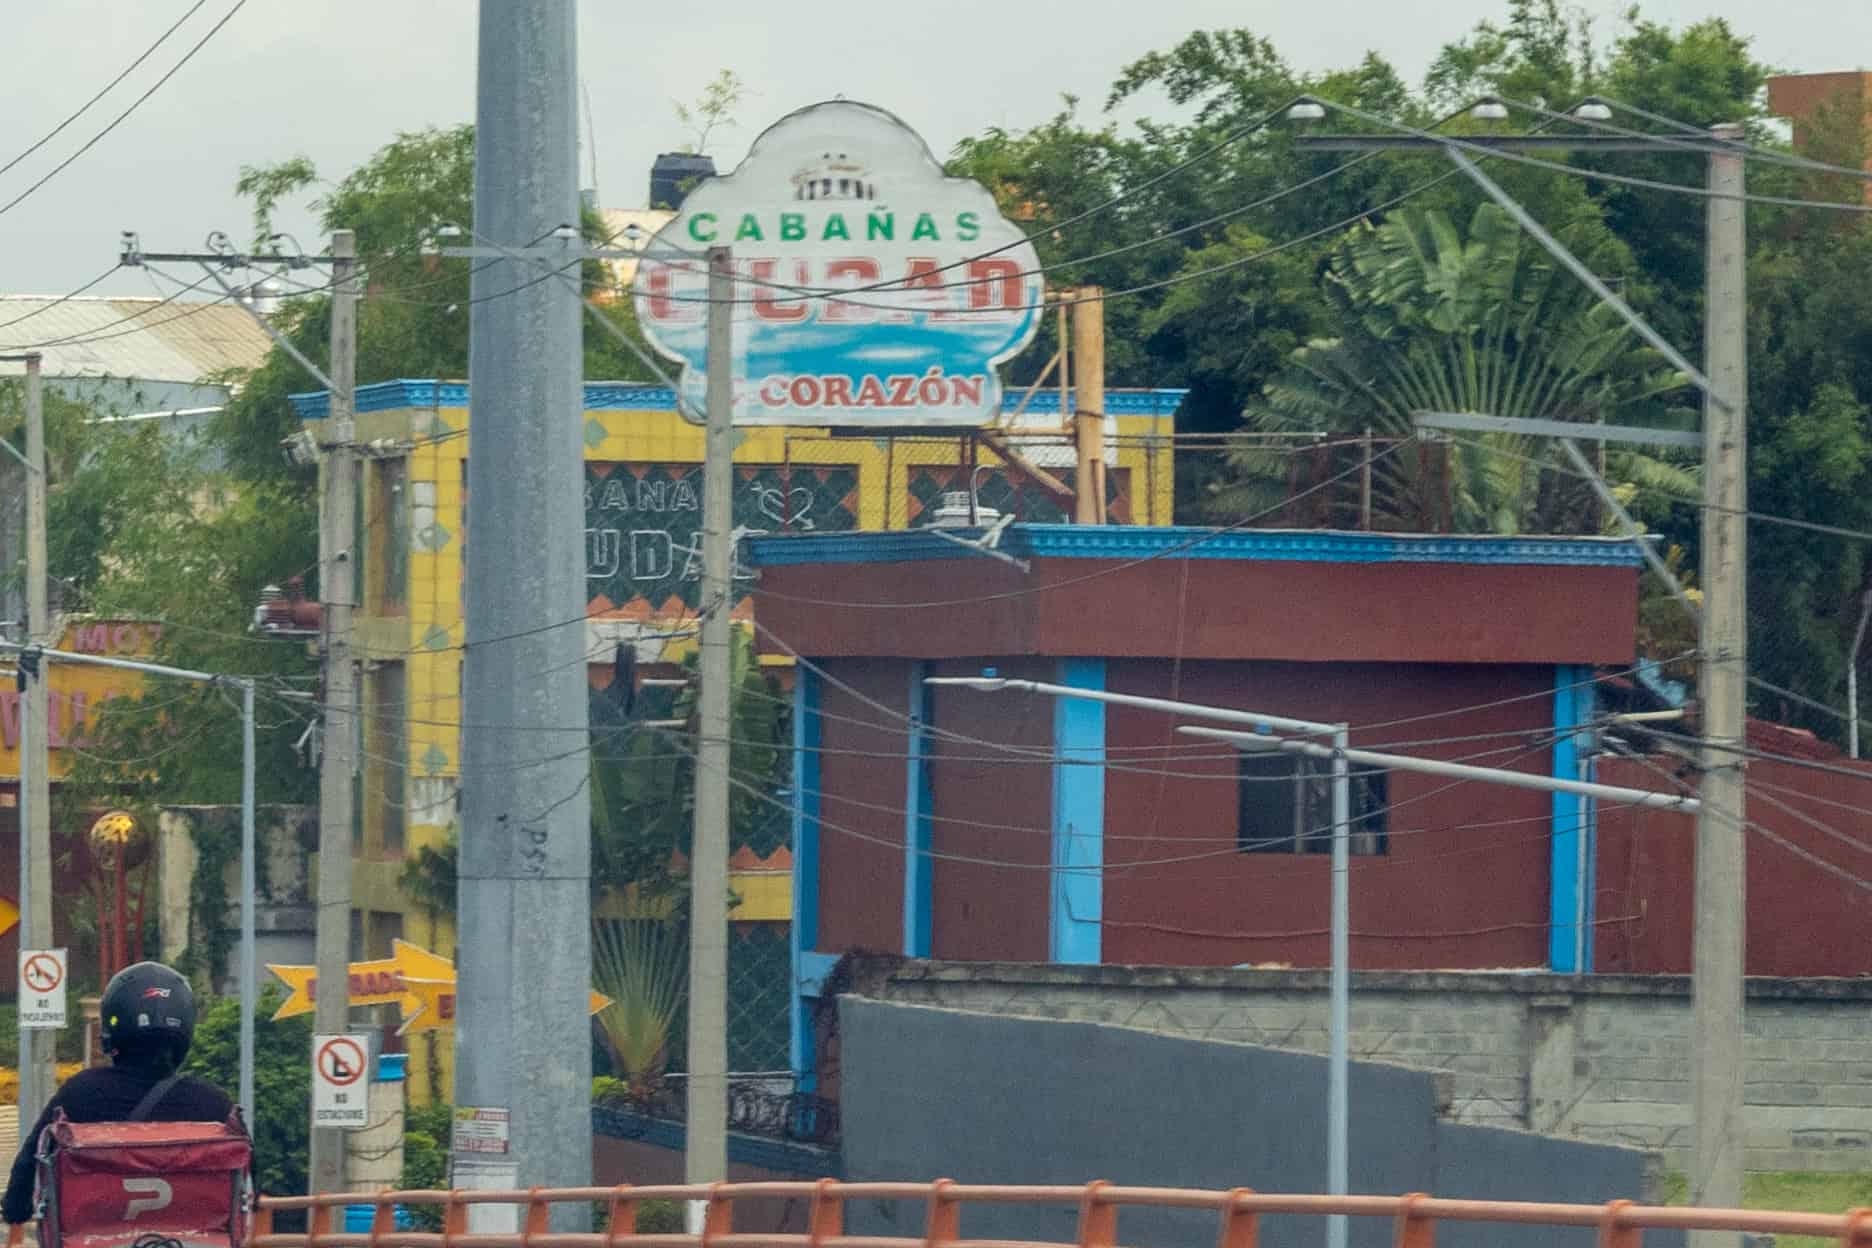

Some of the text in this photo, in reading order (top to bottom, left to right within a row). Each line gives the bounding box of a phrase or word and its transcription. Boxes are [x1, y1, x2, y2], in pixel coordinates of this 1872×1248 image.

[687, 203, 983, 243] CABAÑAS
[642, 256, 1031, 325] CUDAD
[759, 366, 985, 408] CORAZÓN
